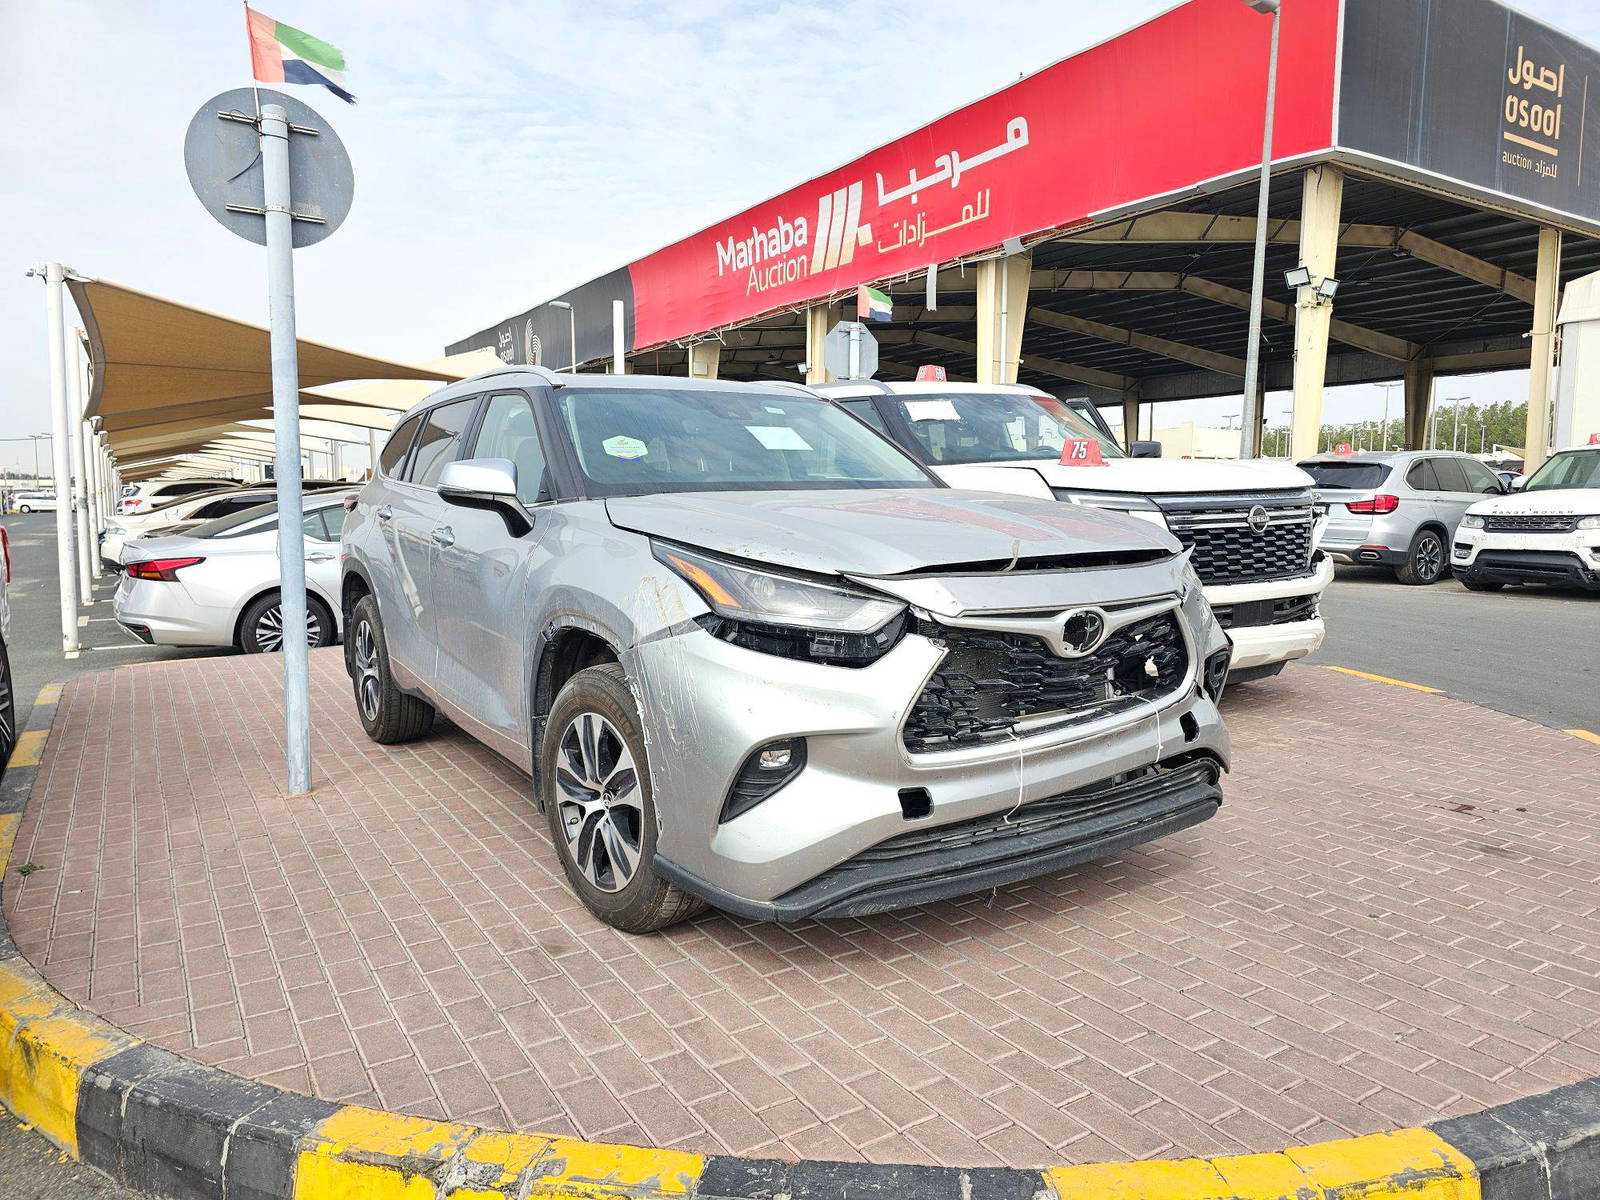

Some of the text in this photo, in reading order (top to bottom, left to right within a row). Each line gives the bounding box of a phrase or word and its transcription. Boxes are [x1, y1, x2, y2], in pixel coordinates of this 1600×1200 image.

[1508, 45, 1565, 97] اصول
[876, 116, 1029, 207] مرحبا
[1502, 150, 1532, 170] auction
[1534, 159, 1558, 178] للمزاد
[878, 188, 990, 253] للمزادات
[715, 215, 808, 277] Marhaba
[746, 254, 807, 296] Auction
[1071, 441, 1088, 459] 75
